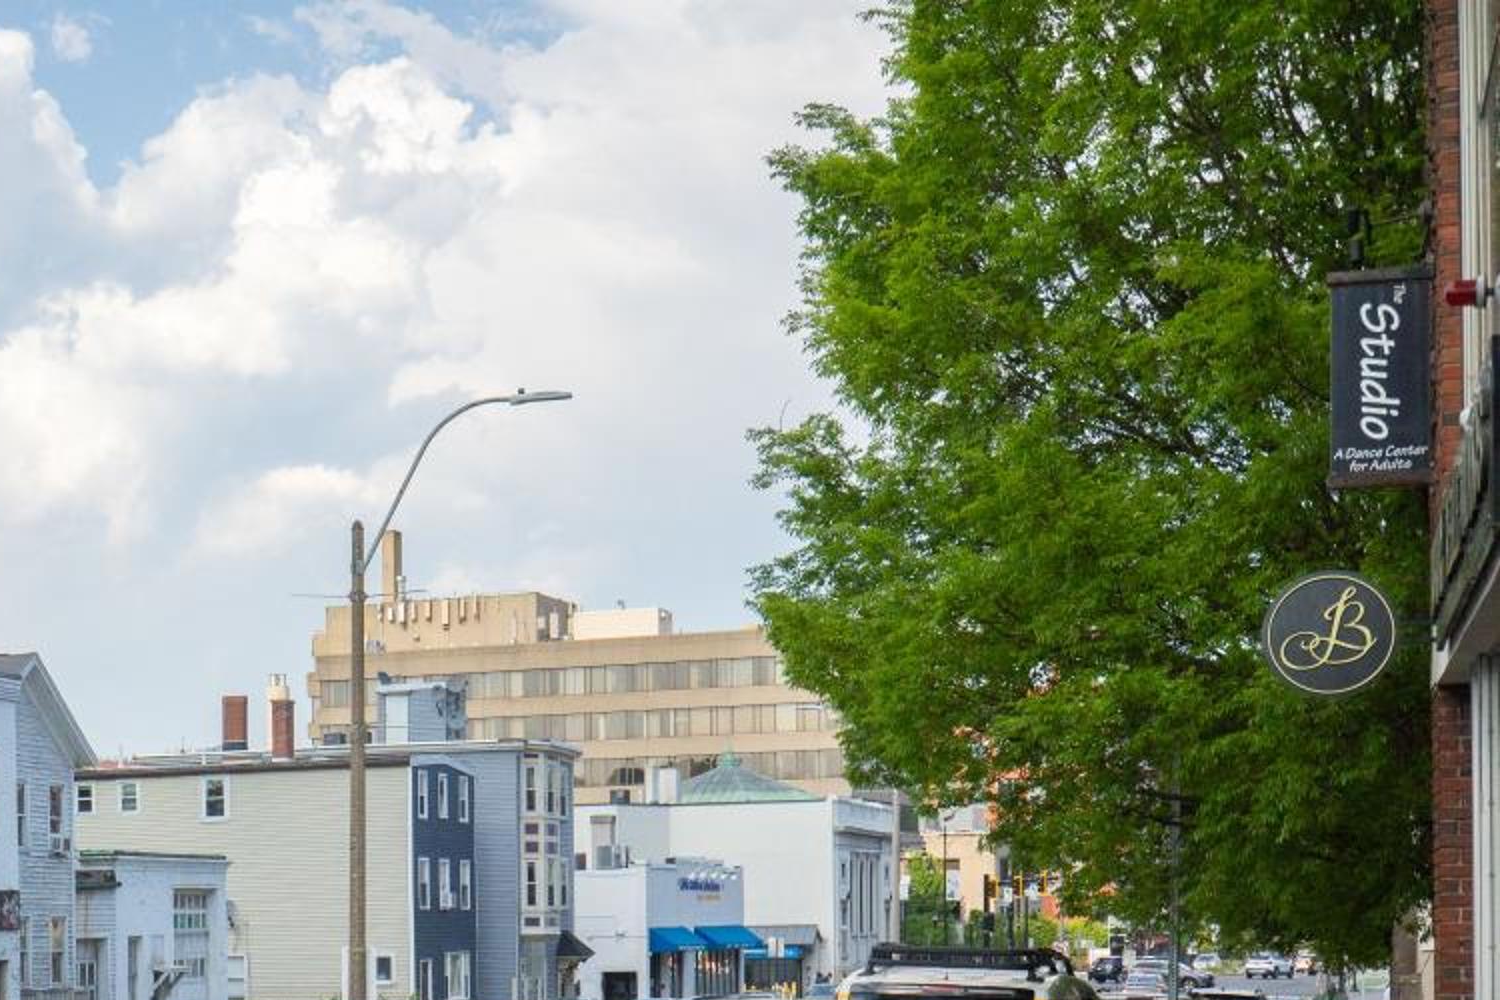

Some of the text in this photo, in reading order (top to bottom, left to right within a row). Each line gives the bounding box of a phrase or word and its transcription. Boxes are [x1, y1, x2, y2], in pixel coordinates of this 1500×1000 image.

[1359, 303, 1401, 440] Studio
[1333, 445, 1428, 460] A Dance Center
[1350, 457, 1413, 472] for Adults
